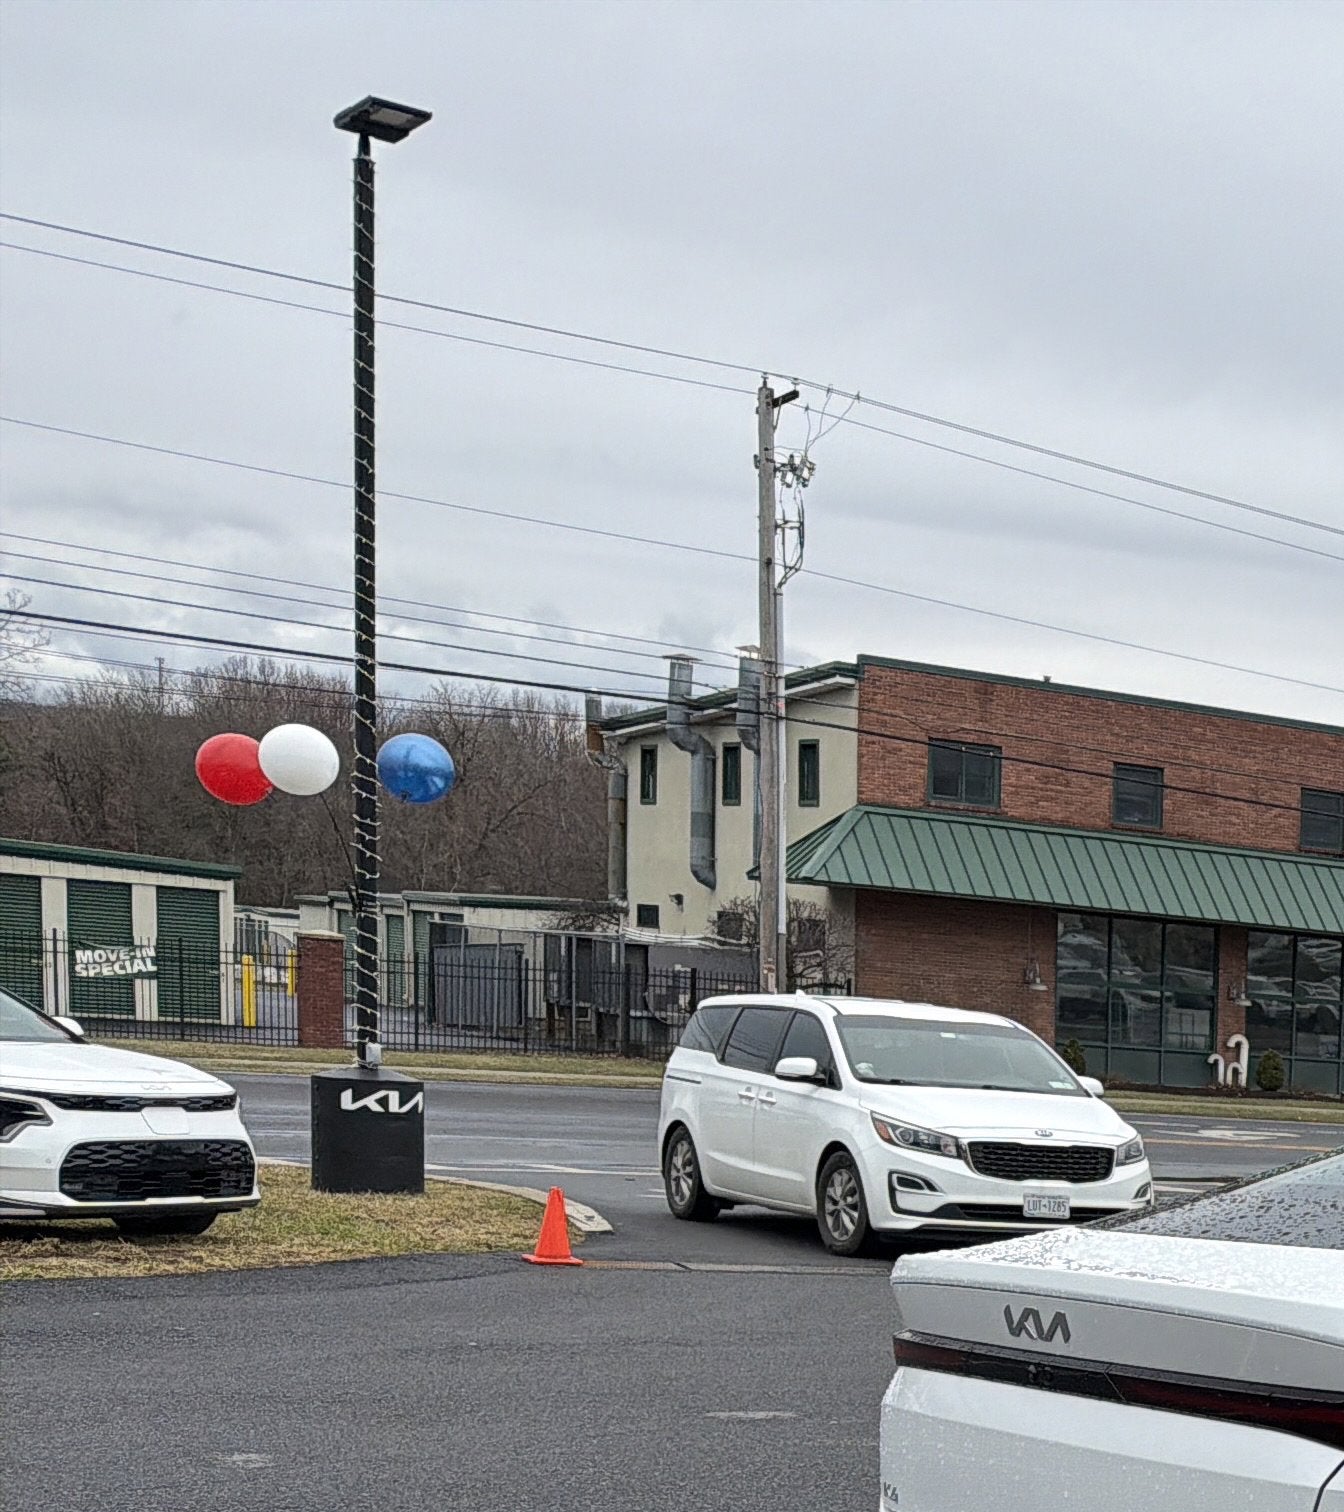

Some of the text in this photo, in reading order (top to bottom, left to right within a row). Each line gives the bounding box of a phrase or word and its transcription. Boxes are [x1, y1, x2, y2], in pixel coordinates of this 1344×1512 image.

[75, 946, 156, 963] MOVE-IN
[75, 957, 158, 977] SPECIAL
[340, 1087, 424, 1113] KIA
[1003, 1304, 1071, 1344] KIA
[883, 1481, 899, 1505] K4
